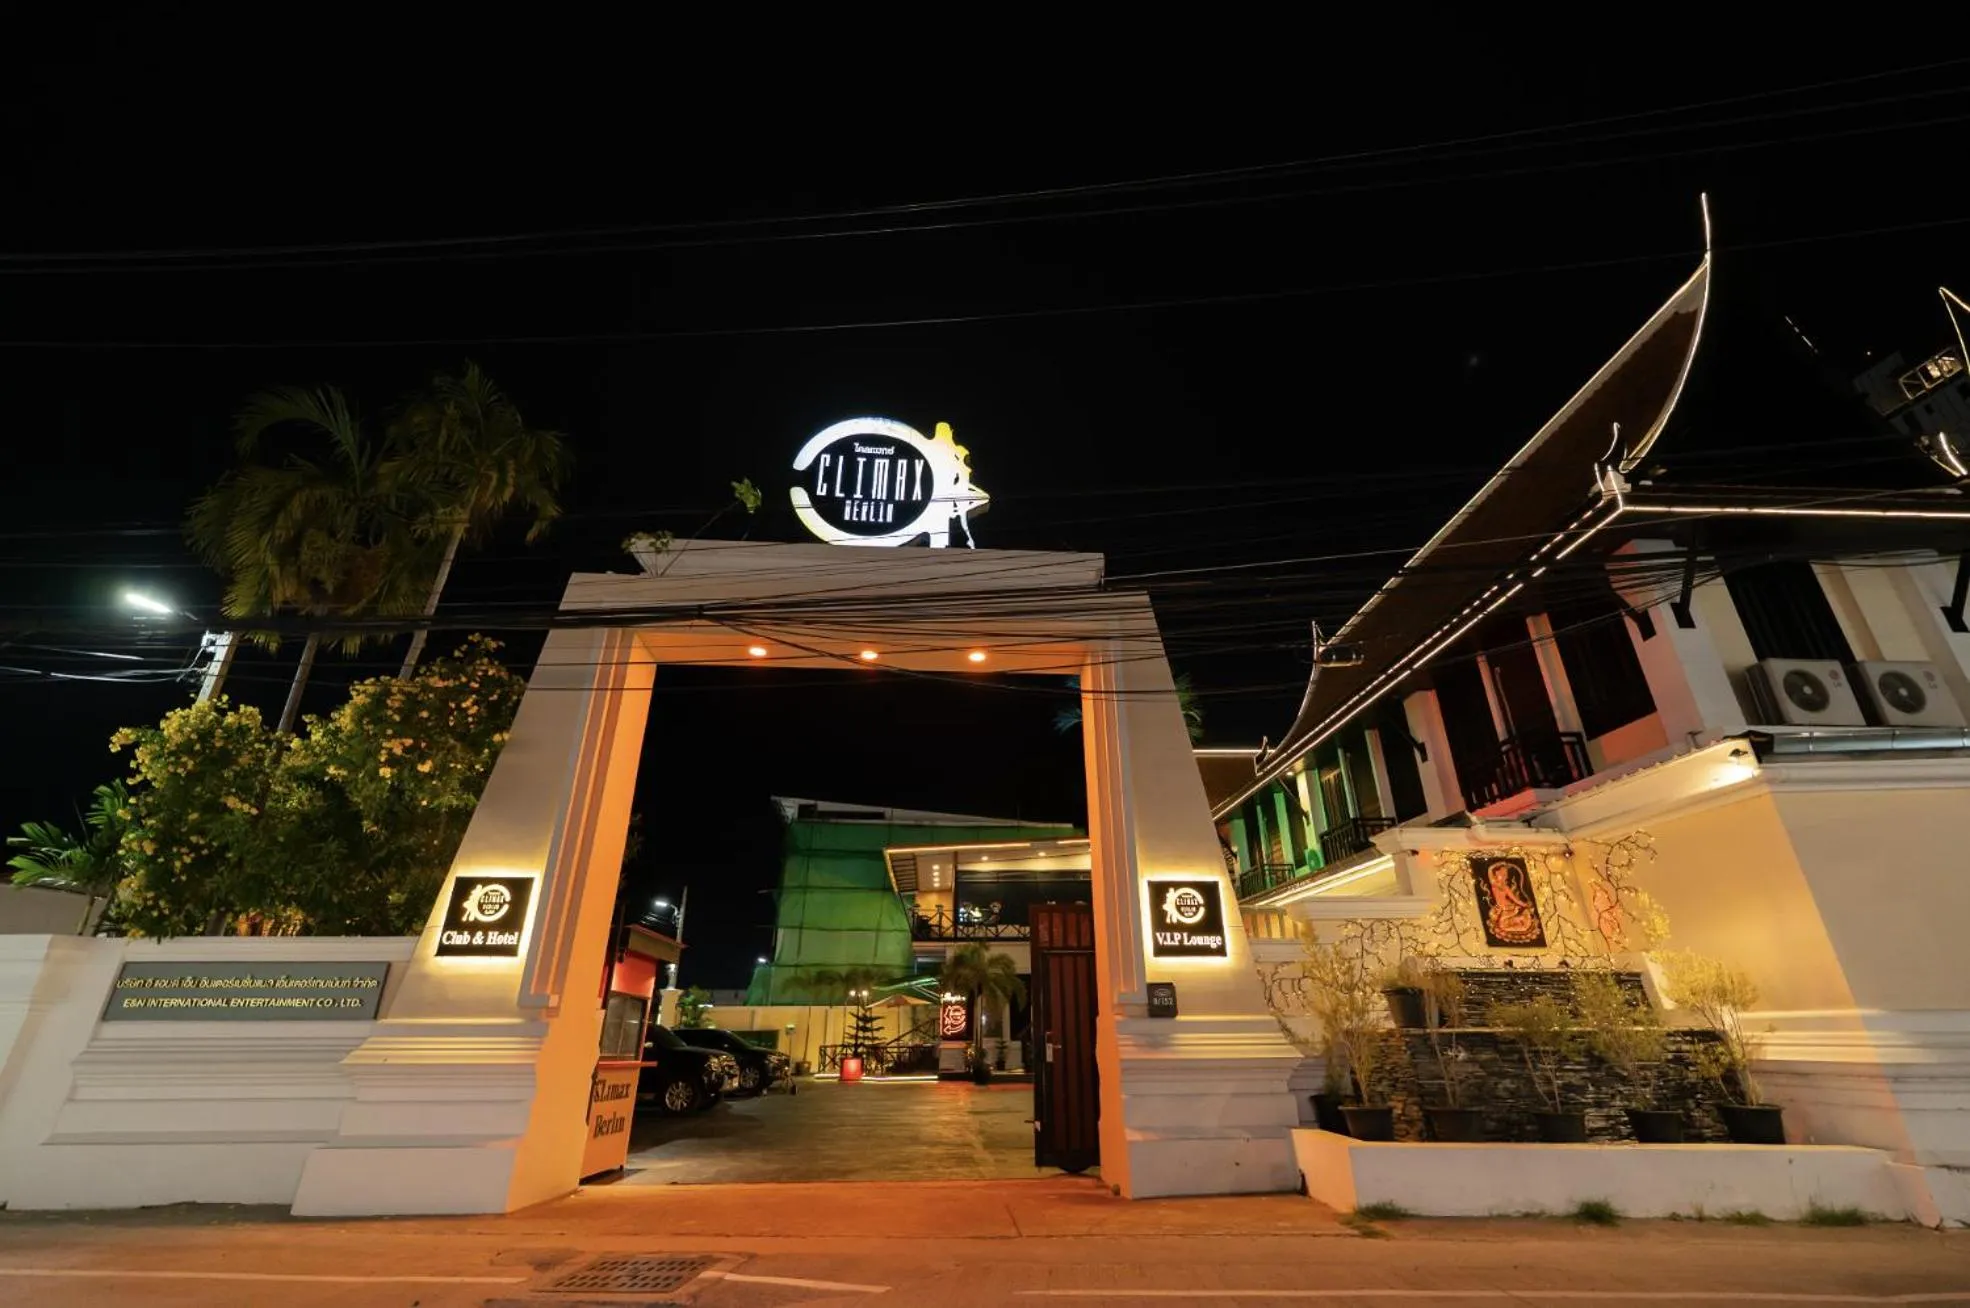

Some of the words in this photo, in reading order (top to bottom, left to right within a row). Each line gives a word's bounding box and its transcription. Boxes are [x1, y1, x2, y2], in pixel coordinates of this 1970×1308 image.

[816, 454, 924, 500] CLIMAX
[844, 500, 894, 522] BERLIN
[442, 931, 470, 945] Club
[472, 931, 484, 945] &
[486, 931, 519, 945] Hotel
[1183, 933, 1222, 948] Lounge
[123, 999, 147, 1008] E&N
[147, 999, 228, 1008] INTERNATIONAL
[229, 998, 315, 1007] ENTERTAINMENT
[593, 1111, 625, 1139] Berlin
